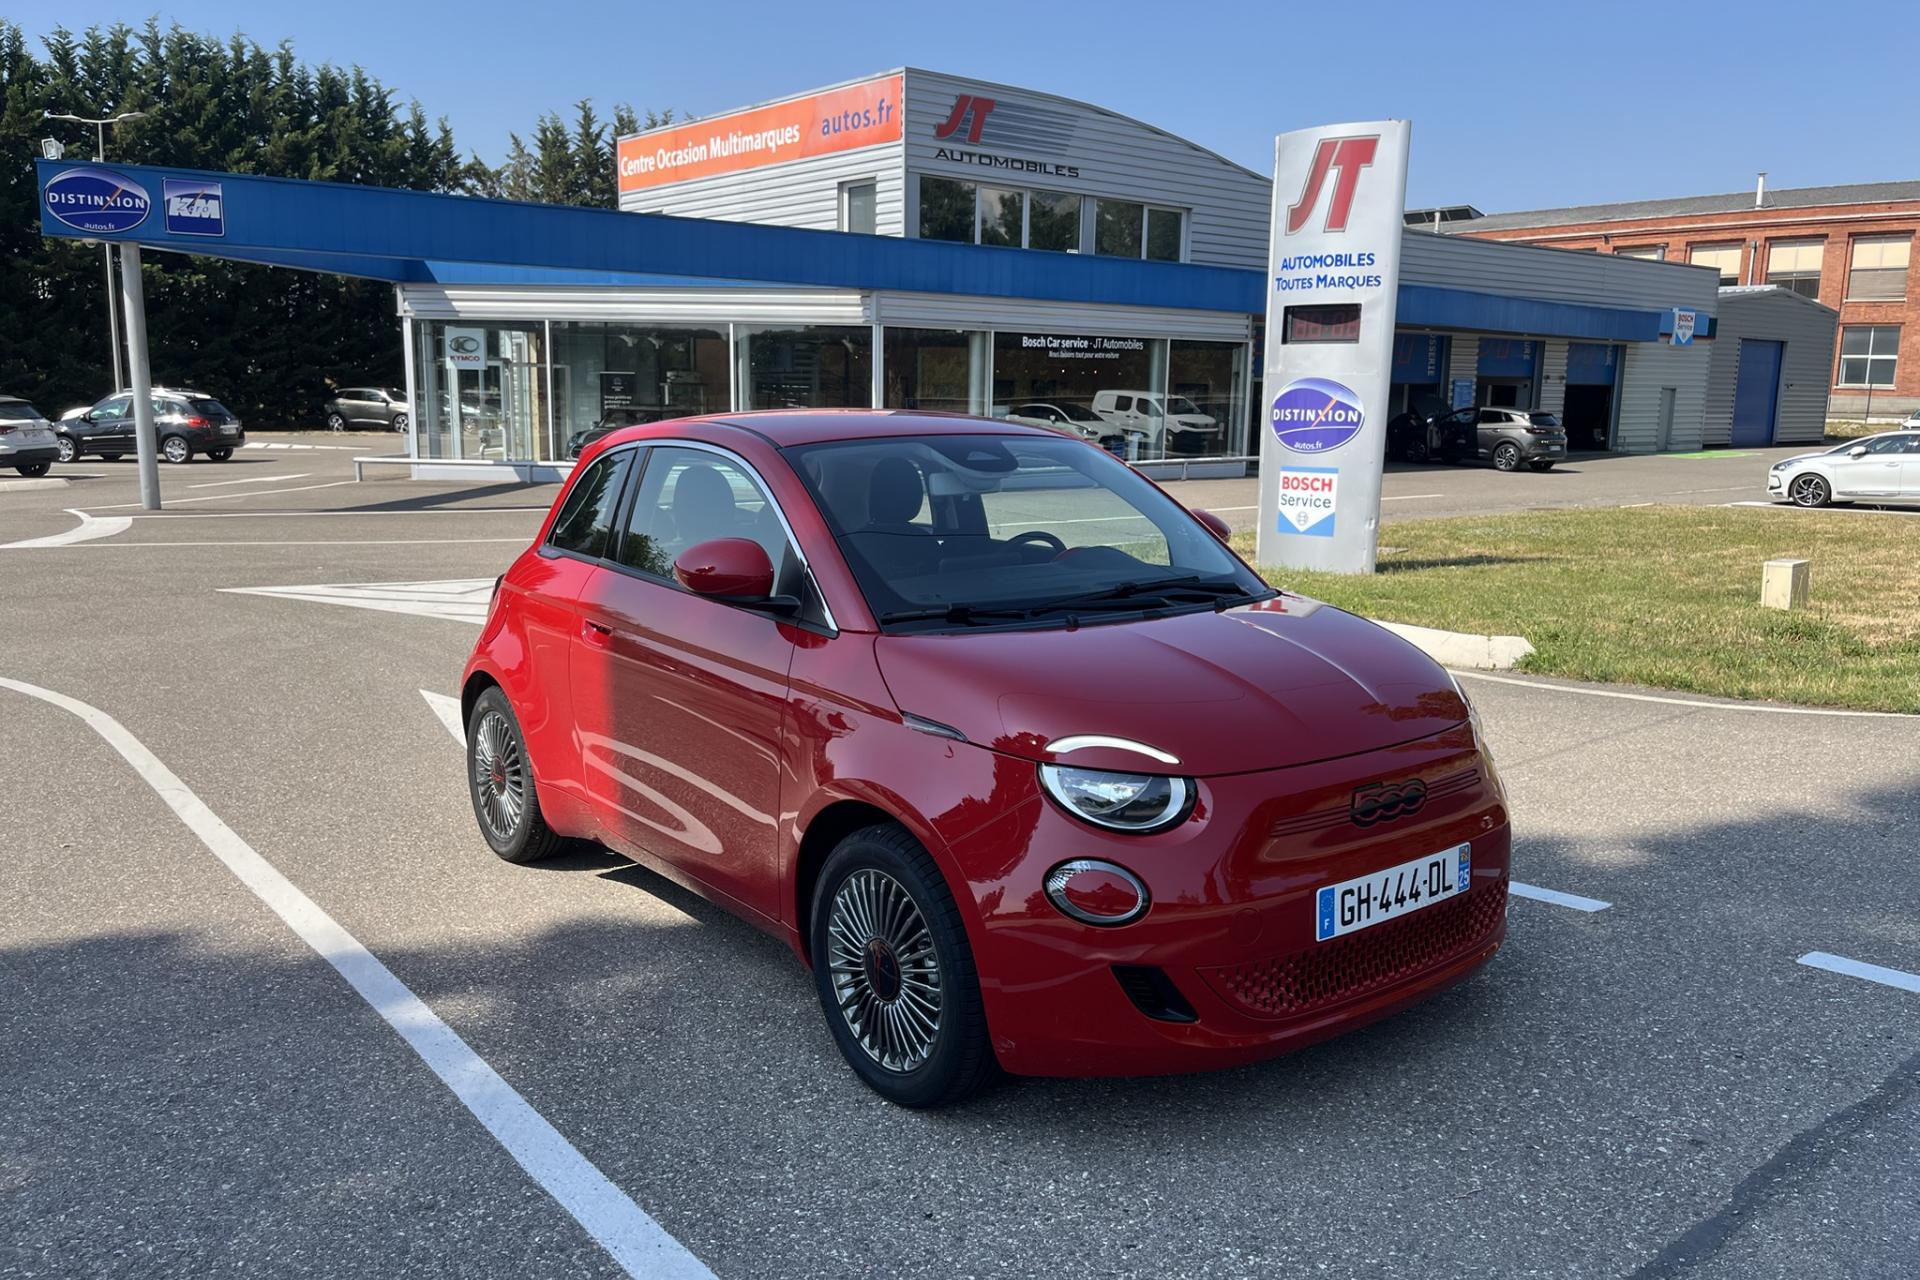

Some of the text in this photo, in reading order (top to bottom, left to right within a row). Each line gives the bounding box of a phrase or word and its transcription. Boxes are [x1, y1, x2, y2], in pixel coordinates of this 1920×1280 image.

[821, 99, 894, 136] autos.fr
[935, 94, 997, 145] JT
[620, 124, 800, 177] Centre Occasion Multimarques
[935, 148, 1080, 178] AUTOMOBILES
[1285, 134, 1381, 236] JT
[48, 191, 145, 210] DISTINXION
[169, 197, 221, 220] KM
[84, 221, 116, 231] autos.fr
[1280, 252, 1376, 271] AUTOMOBILES
[1678, 313, 1694, 323] BOSCH
[1022, 336, 1046, 348] Bosch
[1047, 337, 1061, 348] Car
[1061, 337, 1088, 349] service
[1093, 338, 1102, 349] JT
[1102, 338, 1144, 351] Automobiles
[1273, 408, 1359, 423] DISTINXION
[1294, 440, 1323, 450] autos.fr
[1281, 476, 1334, 493] BOSCH
[1280, 493, 1332, 509] Service
[1351, 778, 1428, 829] 500
[1458, 867, 1470, 887] 25
[1340, 858, 1453, 927] GH-444-DL
[1323, 918, 1330, 930] F
